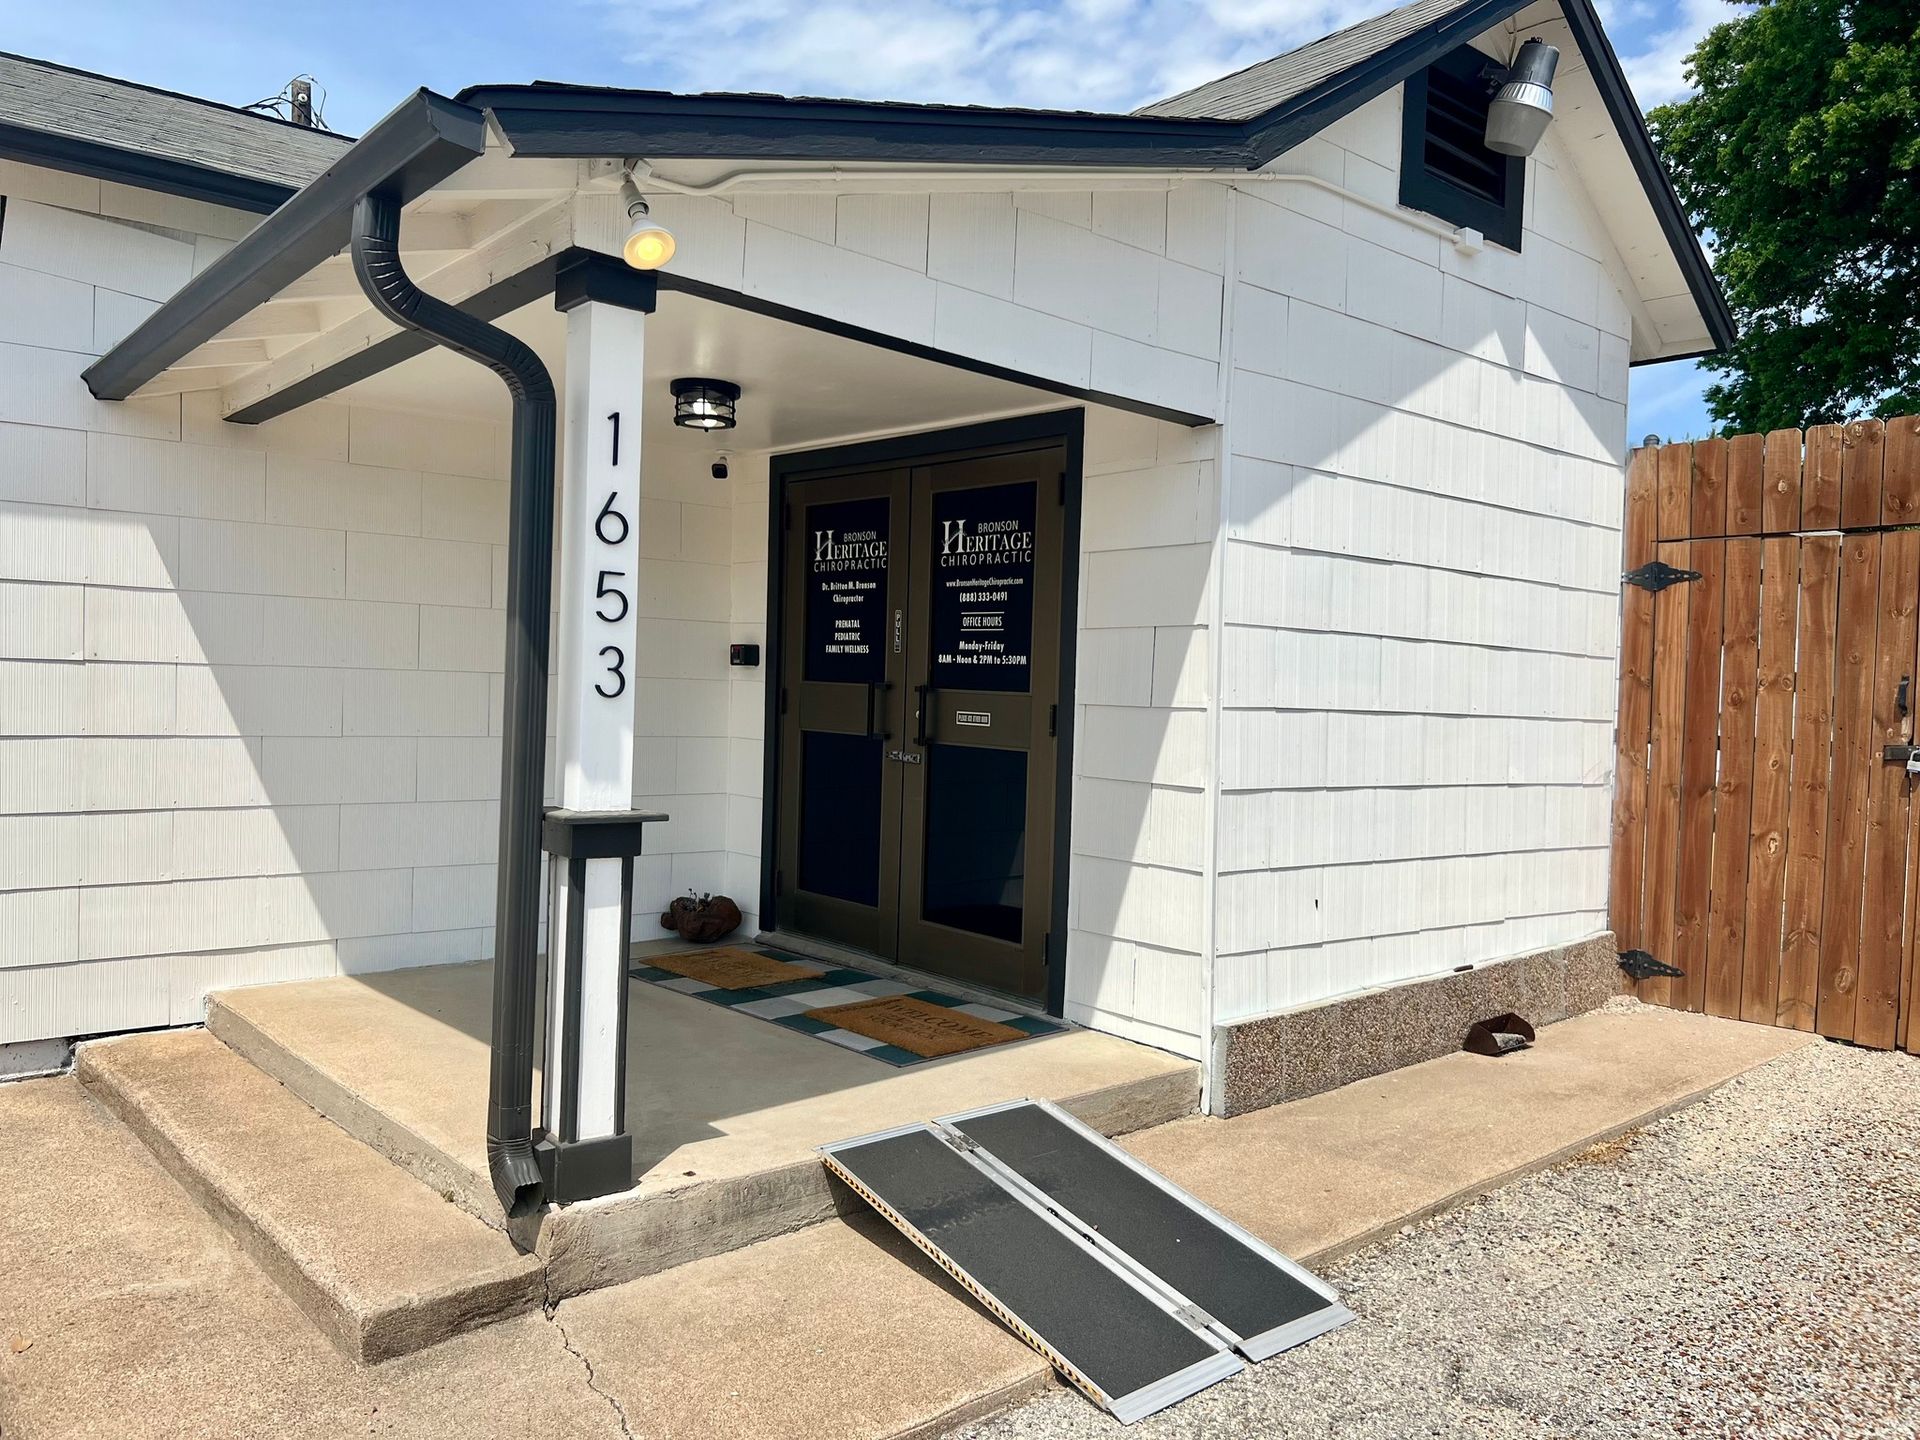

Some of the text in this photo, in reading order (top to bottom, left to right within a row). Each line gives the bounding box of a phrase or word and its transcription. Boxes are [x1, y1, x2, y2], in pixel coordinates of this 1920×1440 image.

[977, 519, 1019, 534] BRONSON
[843, 530, 877, 543] BRONSON
[940, 519, 1032, 555] HERITAGE
[814, 529, 888, 562] HERITAGE
[595, 411, 629, 699] 1653
[940, 550, 1032, 567] CHIROPRACTIC
[813, 557, 887, 573] CHIROPRACTIC
[821, 580, 876, 591] Dr. Britton M. Bronson
[832, 594, 864, 605] Chiropractor
[959, 591, 1008, 602] (888) 333-0491
[835, 619, 861, 628] PRENATAL
[962, 616, 1003, 627] OFFICE HOURS
[834, 632, 861, 641] PEDIATRIC
[825, 644, 870, 654] FAMILY WELLNESS
[959, 640, 1005, 653] Monday-Friday
[938, 654, 952, 664] 8AM
[956, 655, 972, 664] Noon
[972, 655, 979, 664] &
[979, 655, 993, 664] 2PM
[993, 656, 1001, 665] to
[1001, 655, 1027, 665] 5:30PM
[886, 1004, 993, 1039] WELCOME
